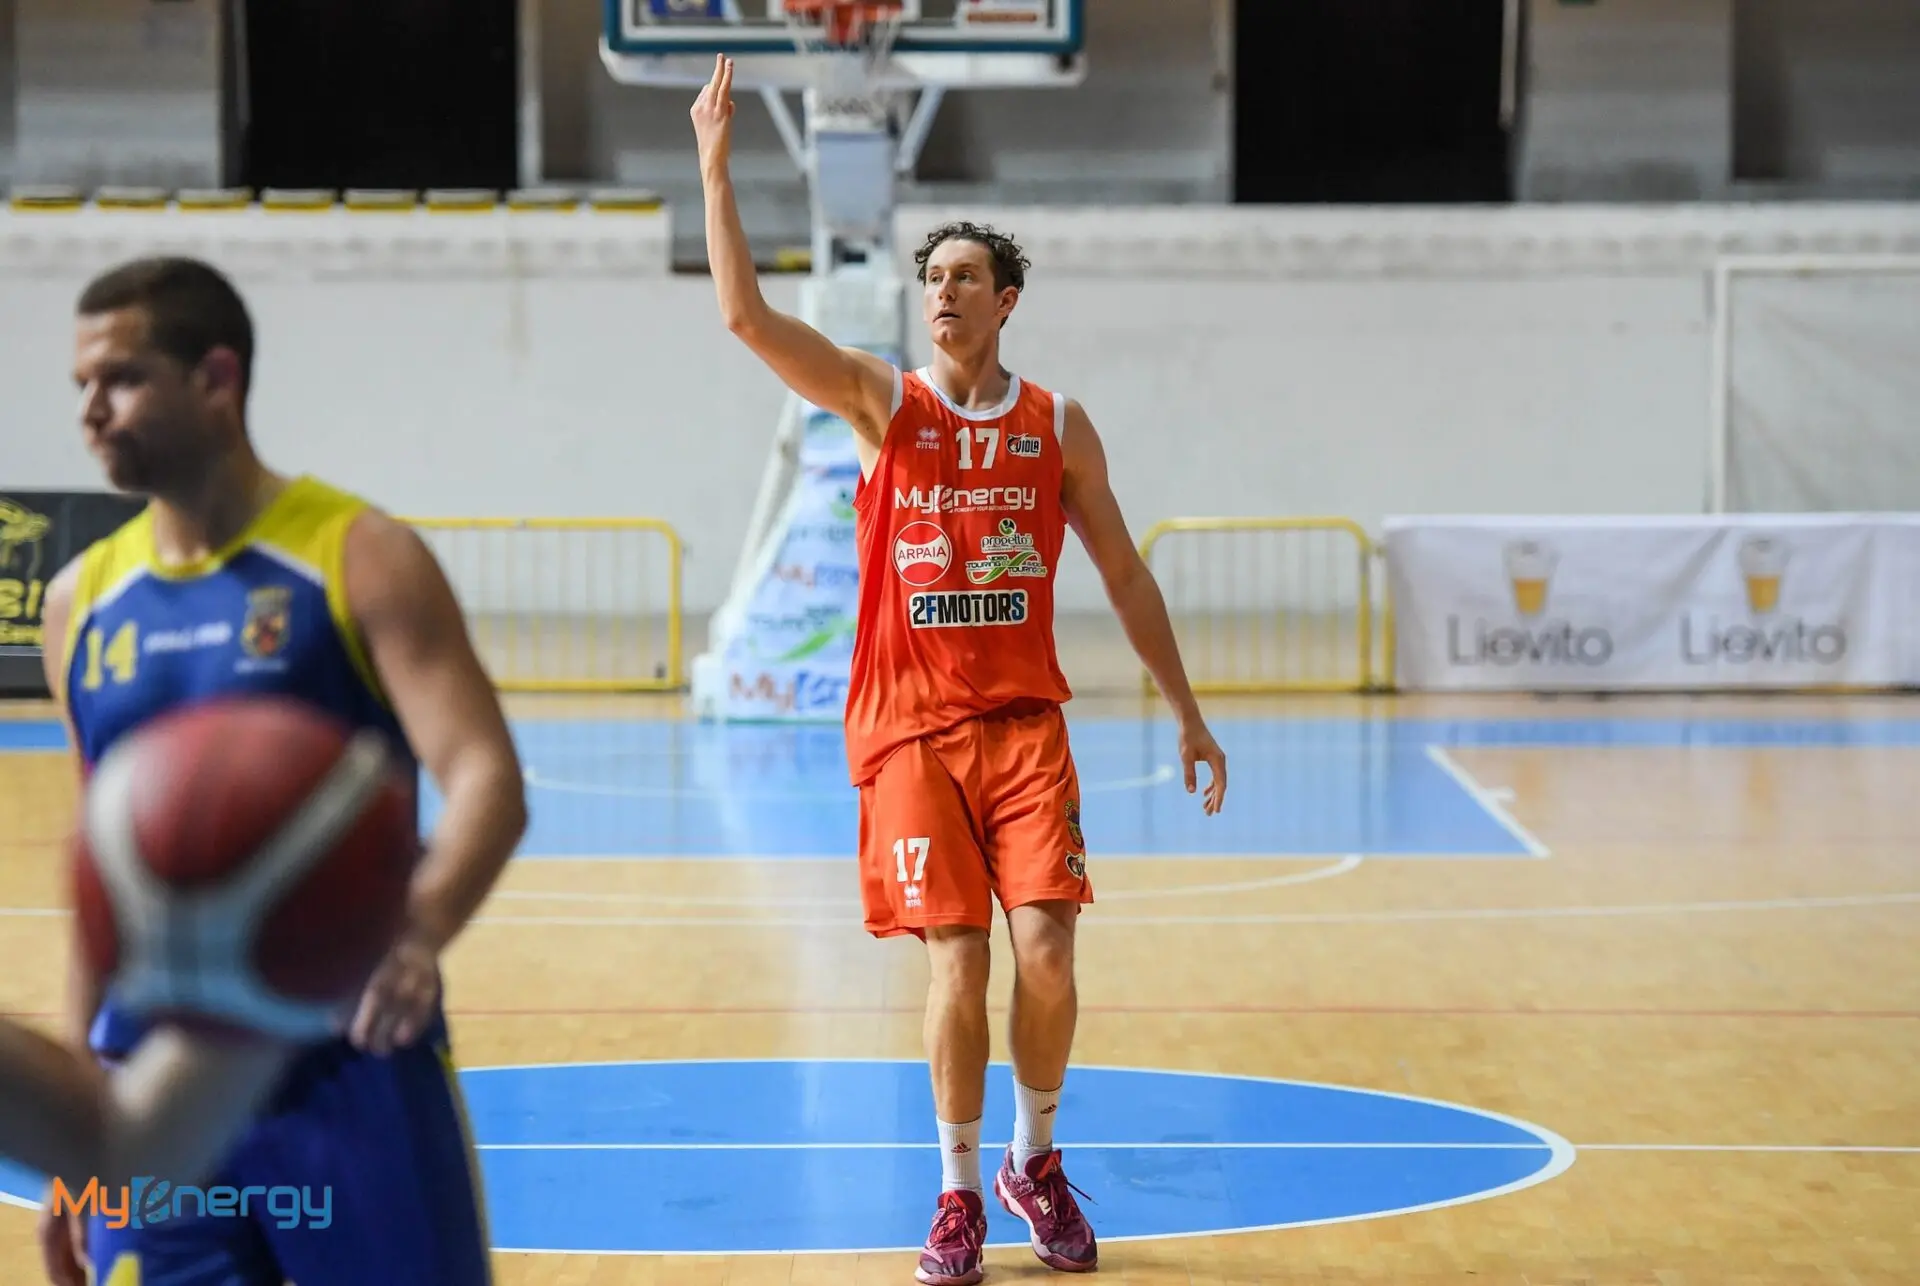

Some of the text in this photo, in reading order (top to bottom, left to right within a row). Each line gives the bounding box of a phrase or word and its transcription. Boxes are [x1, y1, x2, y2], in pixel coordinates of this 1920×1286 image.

[956, 427, 1000, 470] 17
[1016, 439, 1040, 453] VIOLA
[895, 485, 1036, 514] MyEnergy
[898, 546, 946, 560] ARPAIA
[913, 592, 1025, 625] 2FMOTORS
[82, 619, 139, 690] 14
[1447, 613, 1614, 666] Lievito
[1679, 611, 1848, 666] Lievito
[893, 837, 931, 882] 17
